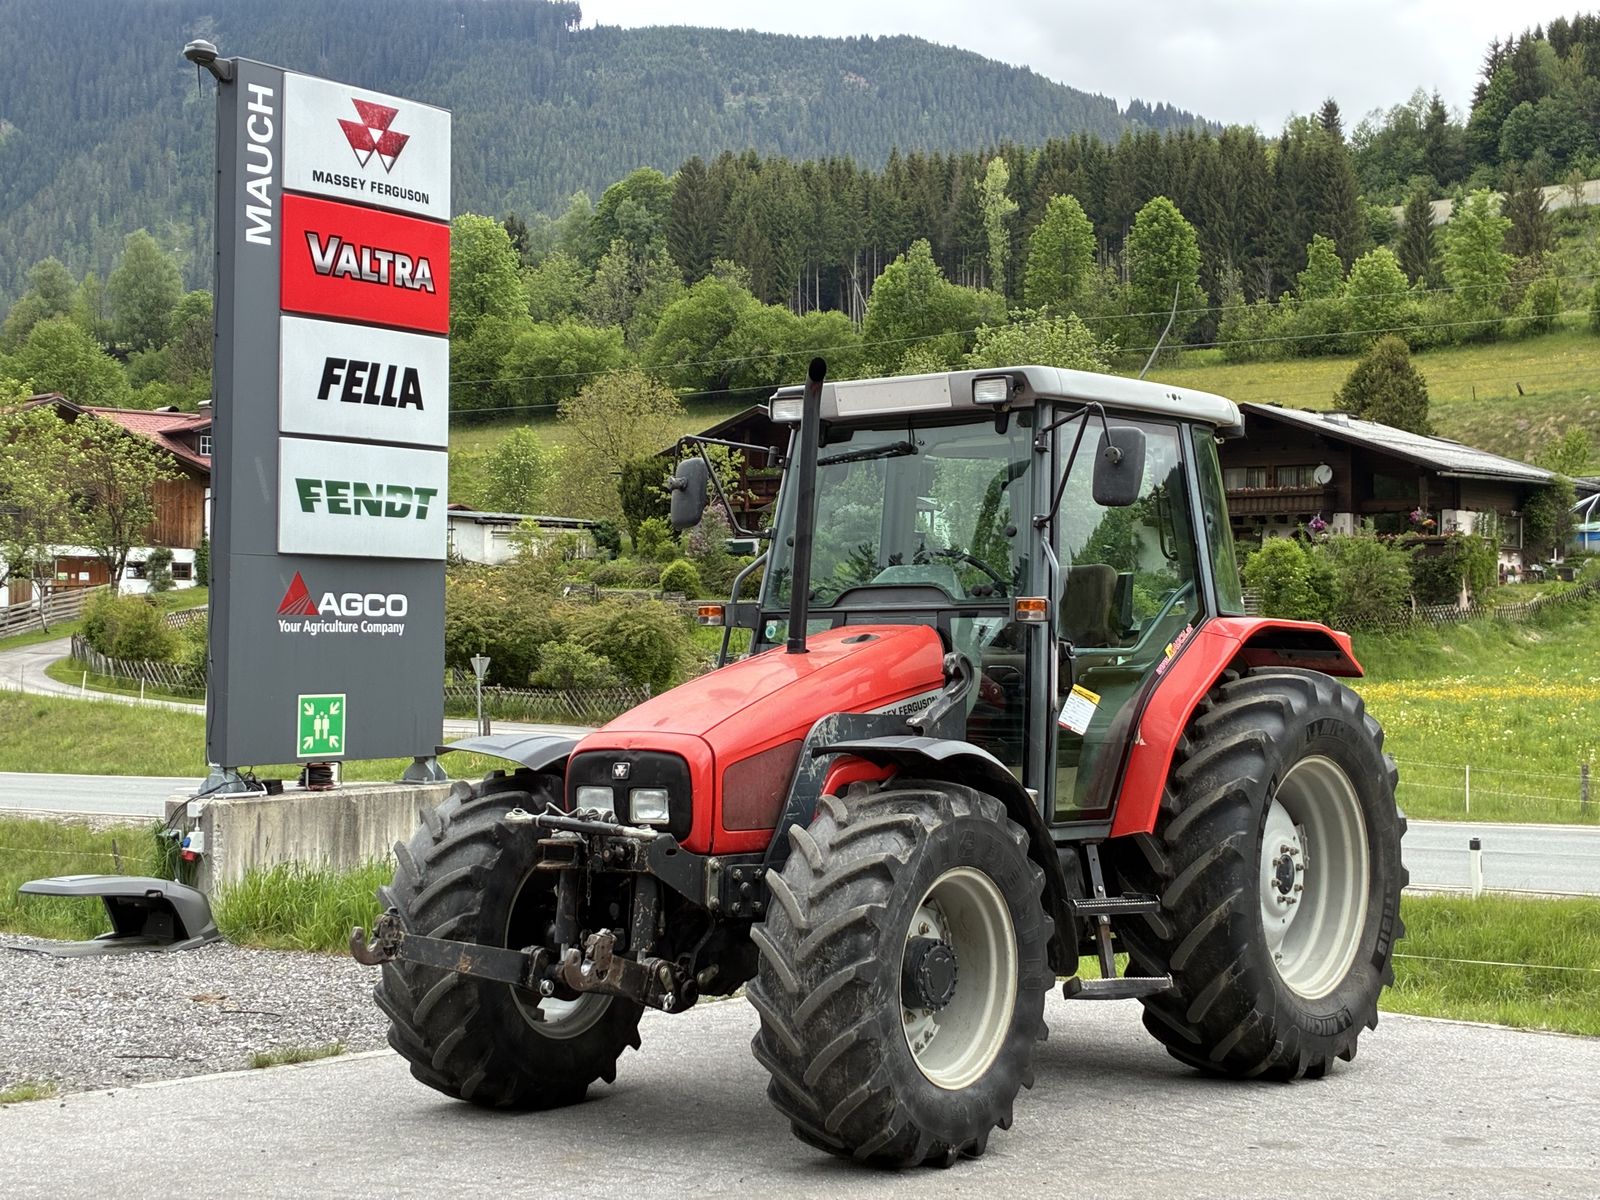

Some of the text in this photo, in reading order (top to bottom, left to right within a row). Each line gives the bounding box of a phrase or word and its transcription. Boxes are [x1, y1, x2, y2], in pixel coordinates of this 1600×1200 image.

[246, 83, 274, 246] MAUCH
[312, 170, 430, 205] MASSEY FERGUSON
[305, 231, 436, 294] VALTRA
[317, 357, 424, 411] FELLA
[295, 478, 438, 520] FENDT
[318, 592, 408, 617] AGCO
[278, 619, 404, 636] Your Agriculture Company
